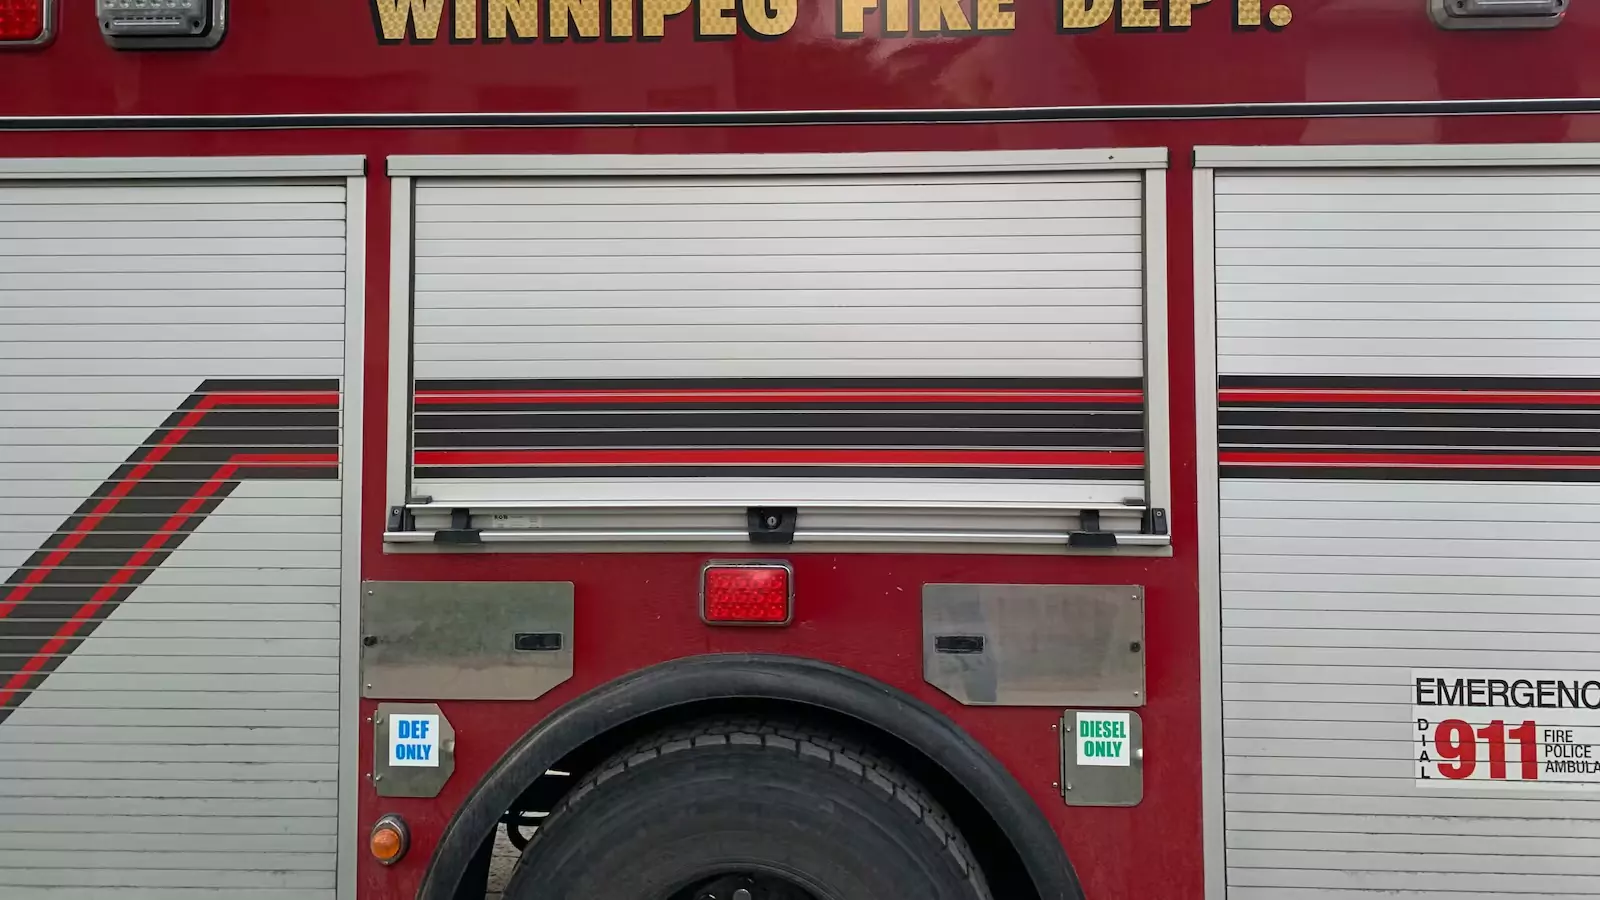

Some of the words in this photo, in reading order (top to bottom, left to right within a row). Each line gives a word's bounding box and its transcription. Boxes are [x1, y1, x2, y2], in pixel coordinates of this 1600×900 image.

[373, 0, 799, 41] WINNIPEG
[398, 720, 430, 739] DEF
[1079, 720, 1127, 738] DIESEL
[1543, 729, 1574, 743] FIRE
[395, 743, 432, 760] ONLY
[1083, 740, 1123, 758] ONLY
[1434, 718, 1539, 780] 911
[1544, 744, 1592, 759] POLICE
